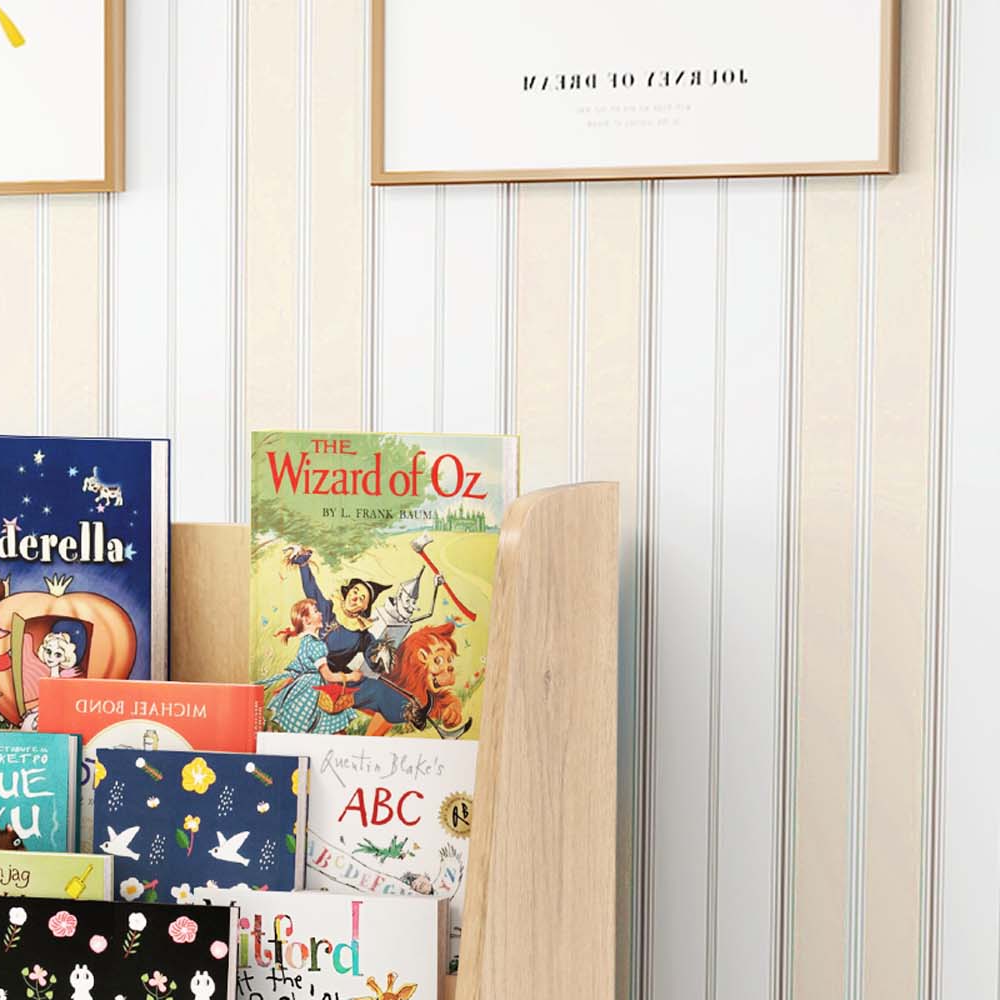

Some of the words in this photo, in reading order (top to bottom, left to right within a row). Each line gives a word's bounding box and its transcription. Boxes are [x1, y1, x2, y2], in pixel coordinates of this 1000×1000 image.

[311, 439, 357, 455] THE
[266, 451, 383, 497] Wizard
[389, 451, 427, 497] of
[431, 453, 488, 500] Oz
[322, 507, 337, 519] BY
[341, 508, 351, 519] L.
[356, 508, 394, 520] FRANK
[399, 509, 433, 521] BAUM
[320, 748, 382, 788] Quentin
[380, 752, 446, 780] Blake's
[338, 787, 425, 828] ABC
[0, 864, 31, 888] jag
[266, 967, 303, 992] the
